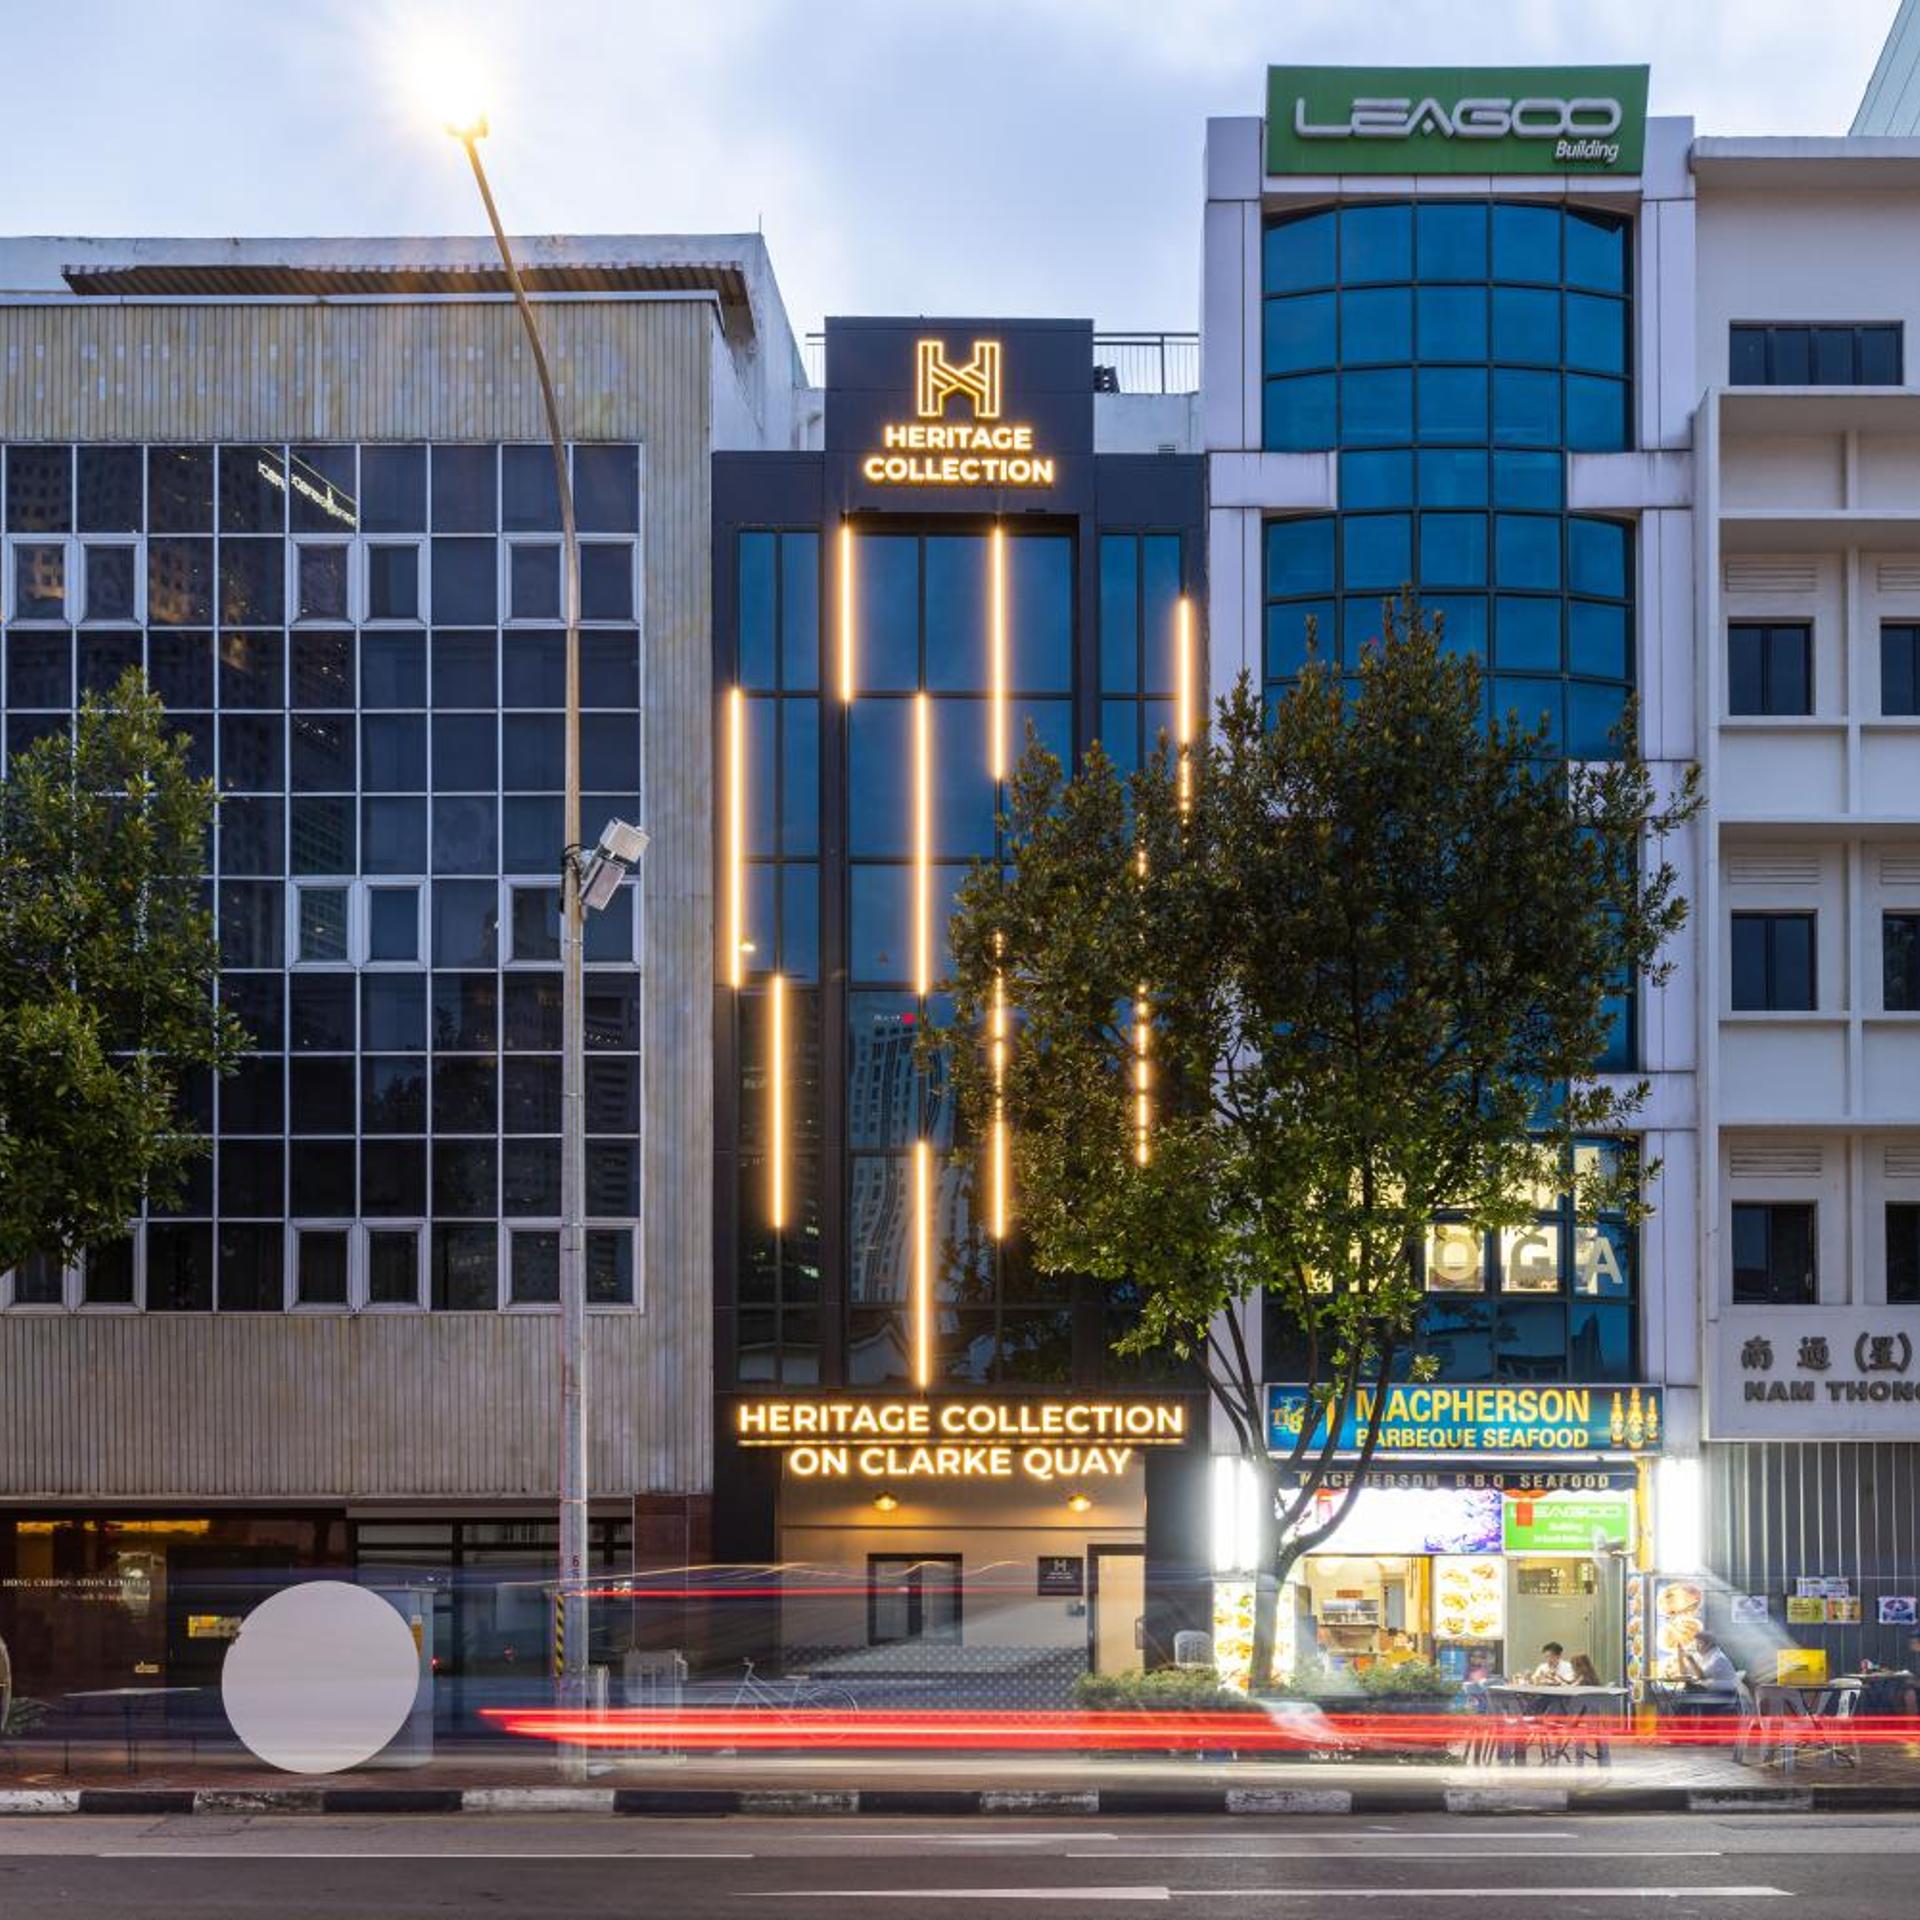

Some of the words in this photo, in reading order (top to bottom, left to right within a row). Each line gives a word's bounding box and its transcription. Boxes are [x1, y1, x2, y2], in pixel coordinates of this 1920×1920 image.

[1294, 97, 1622, 139] LEAGOO
[1554, 140, 1619, 163] Building
[884, 425, 1033, 450] HERITAGE
[864, 457, 1055, 483] COLLECTION
[1434, 1235, 1623, 1291] OGA
[1744, 1381, 1815, 1402] NAM
[1825, 1381, 1920, 1402] THON
[1355, 1389, 1590, 1423] MACPHERSON
[738, 1404, 931, 1435] HERITAGE
[941, 1404, 1184, 1435] COLLECTION
[1482, 1428, 1589, 1449] SEAFOOD
[789, 1447, 849, 1476] ON
[860, 1447, 1013, 1476] CLARKE
[1023, 1447, 1132, 1480] QUAY
[1520, 1474, 1609, 1488] SEAFOOD
